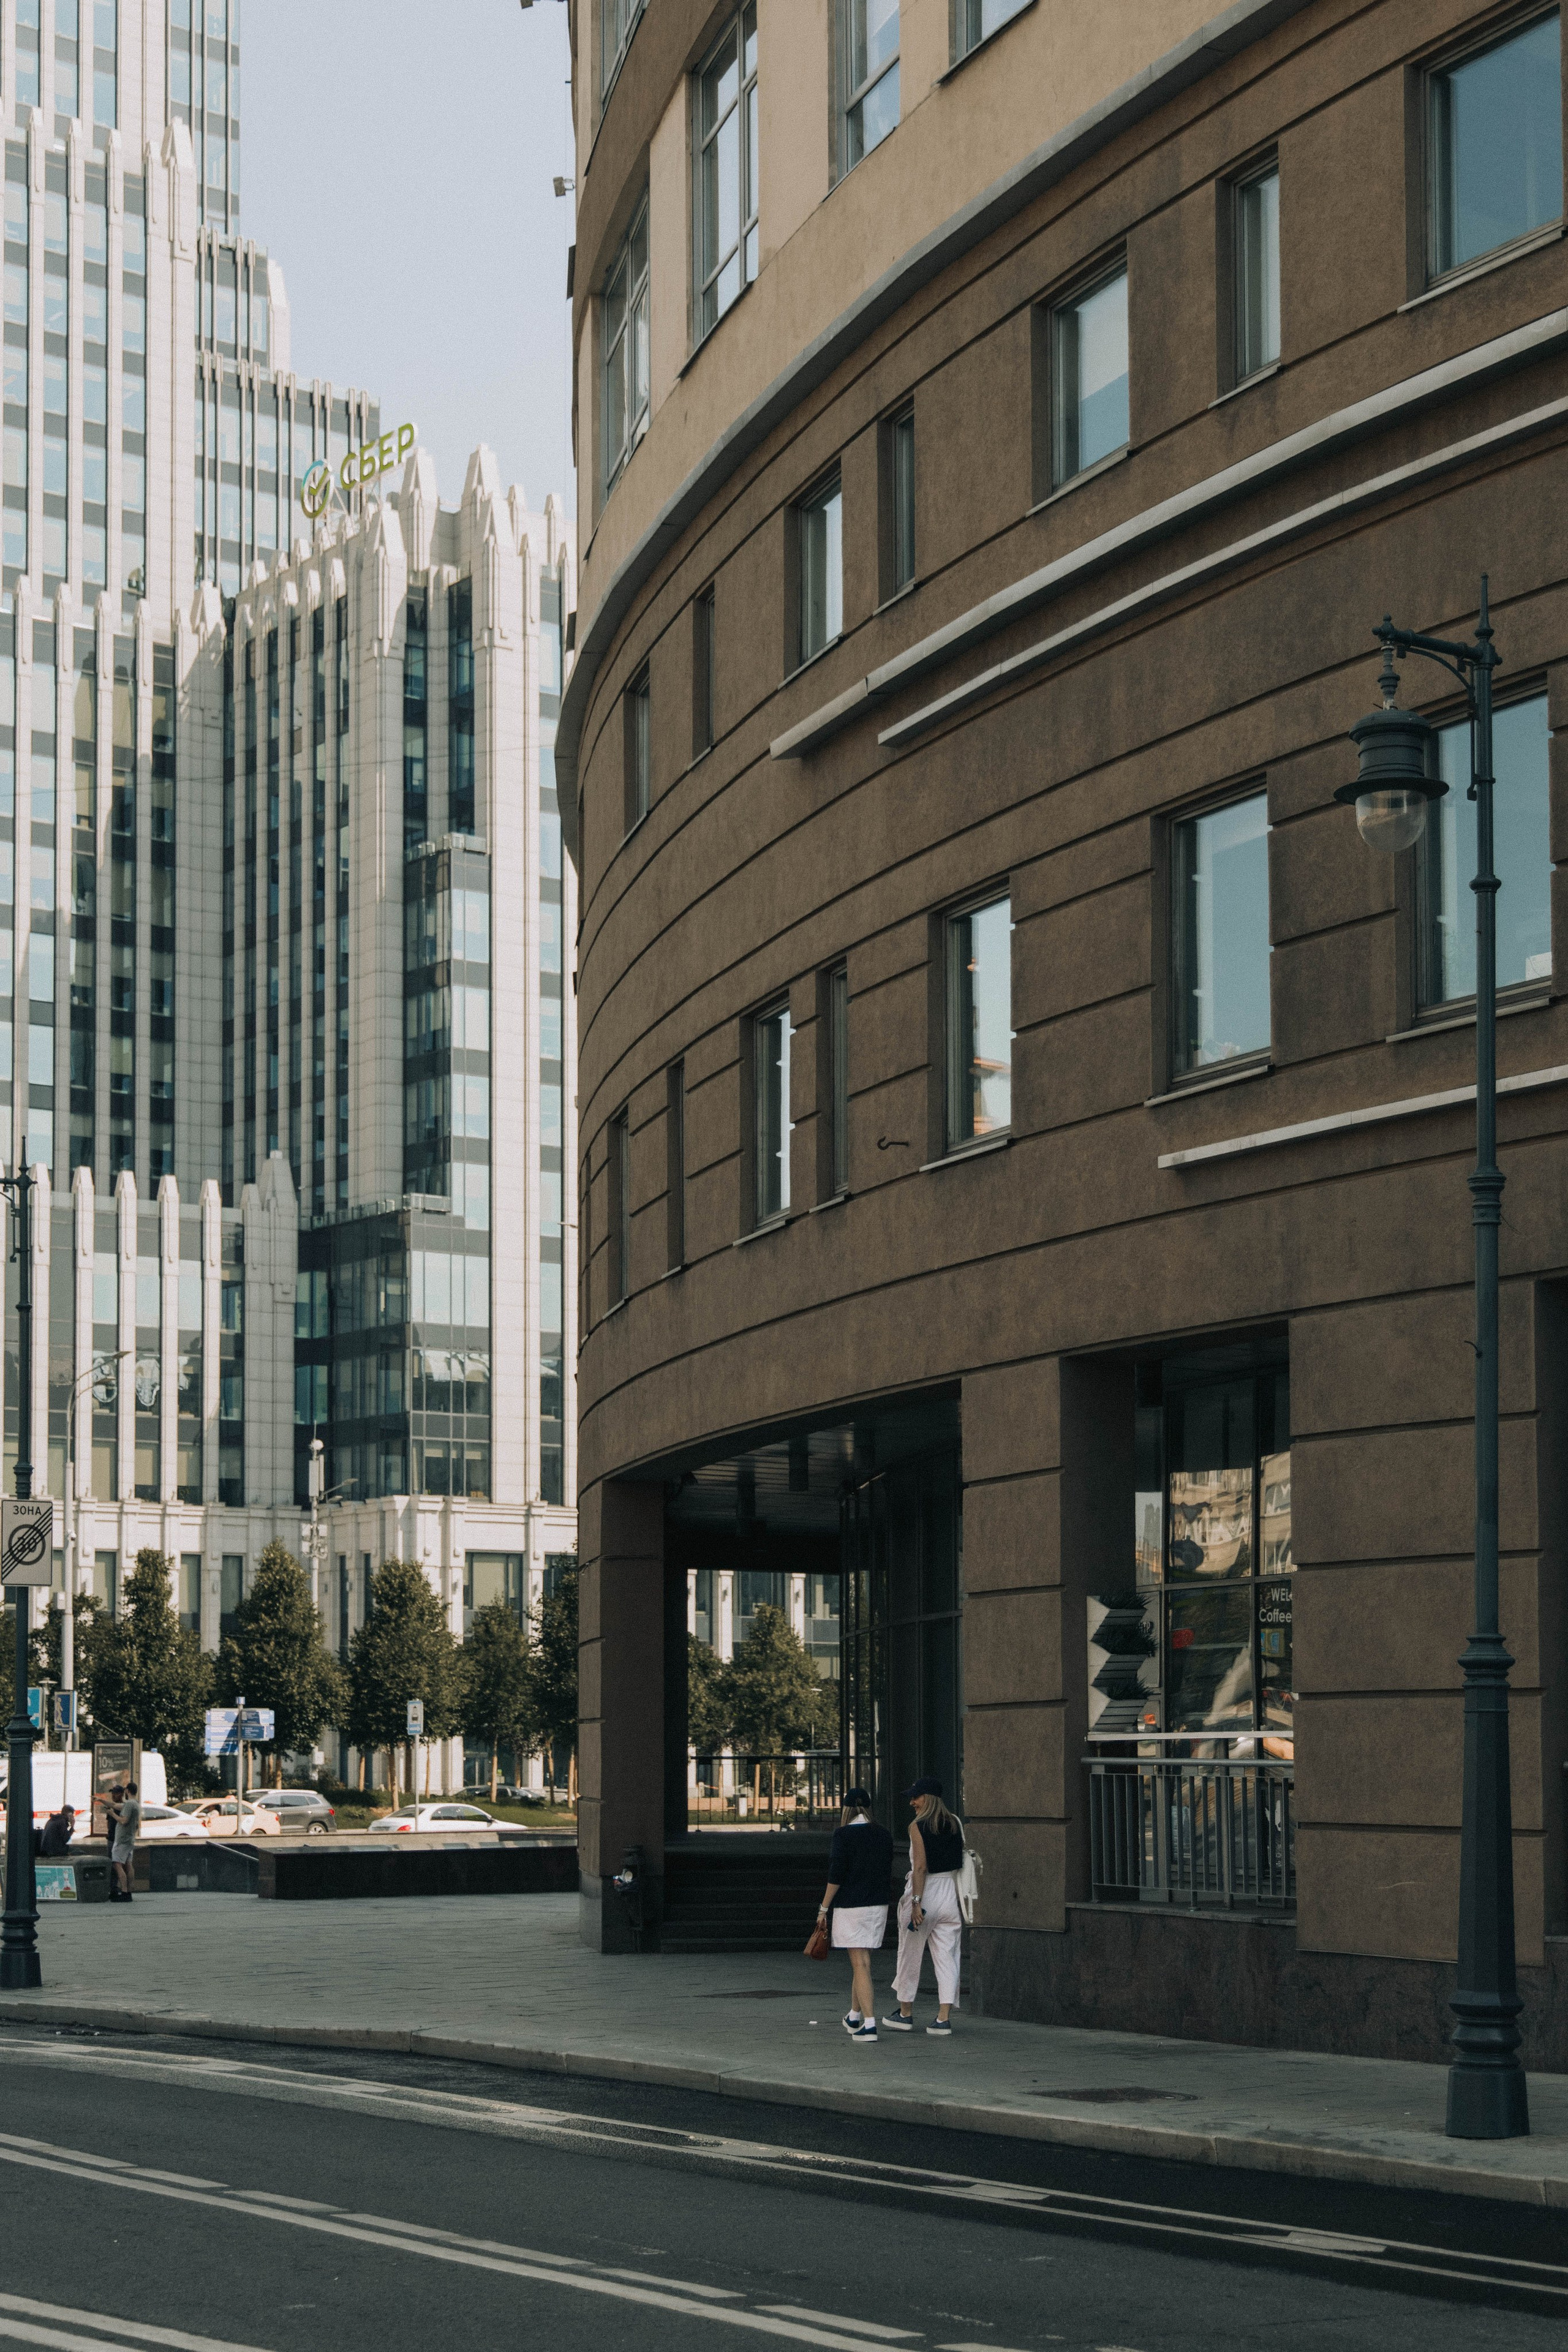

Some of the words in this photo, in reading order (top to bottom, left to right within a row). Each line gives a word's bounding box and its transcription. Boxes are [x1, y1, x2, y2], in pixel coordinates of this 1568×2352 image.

[340, 423, 415, 490] СБЕР
[13, 1505, 42, 1515] ЗОНА
[1259, 1608, 1292, 1623] Coffee
